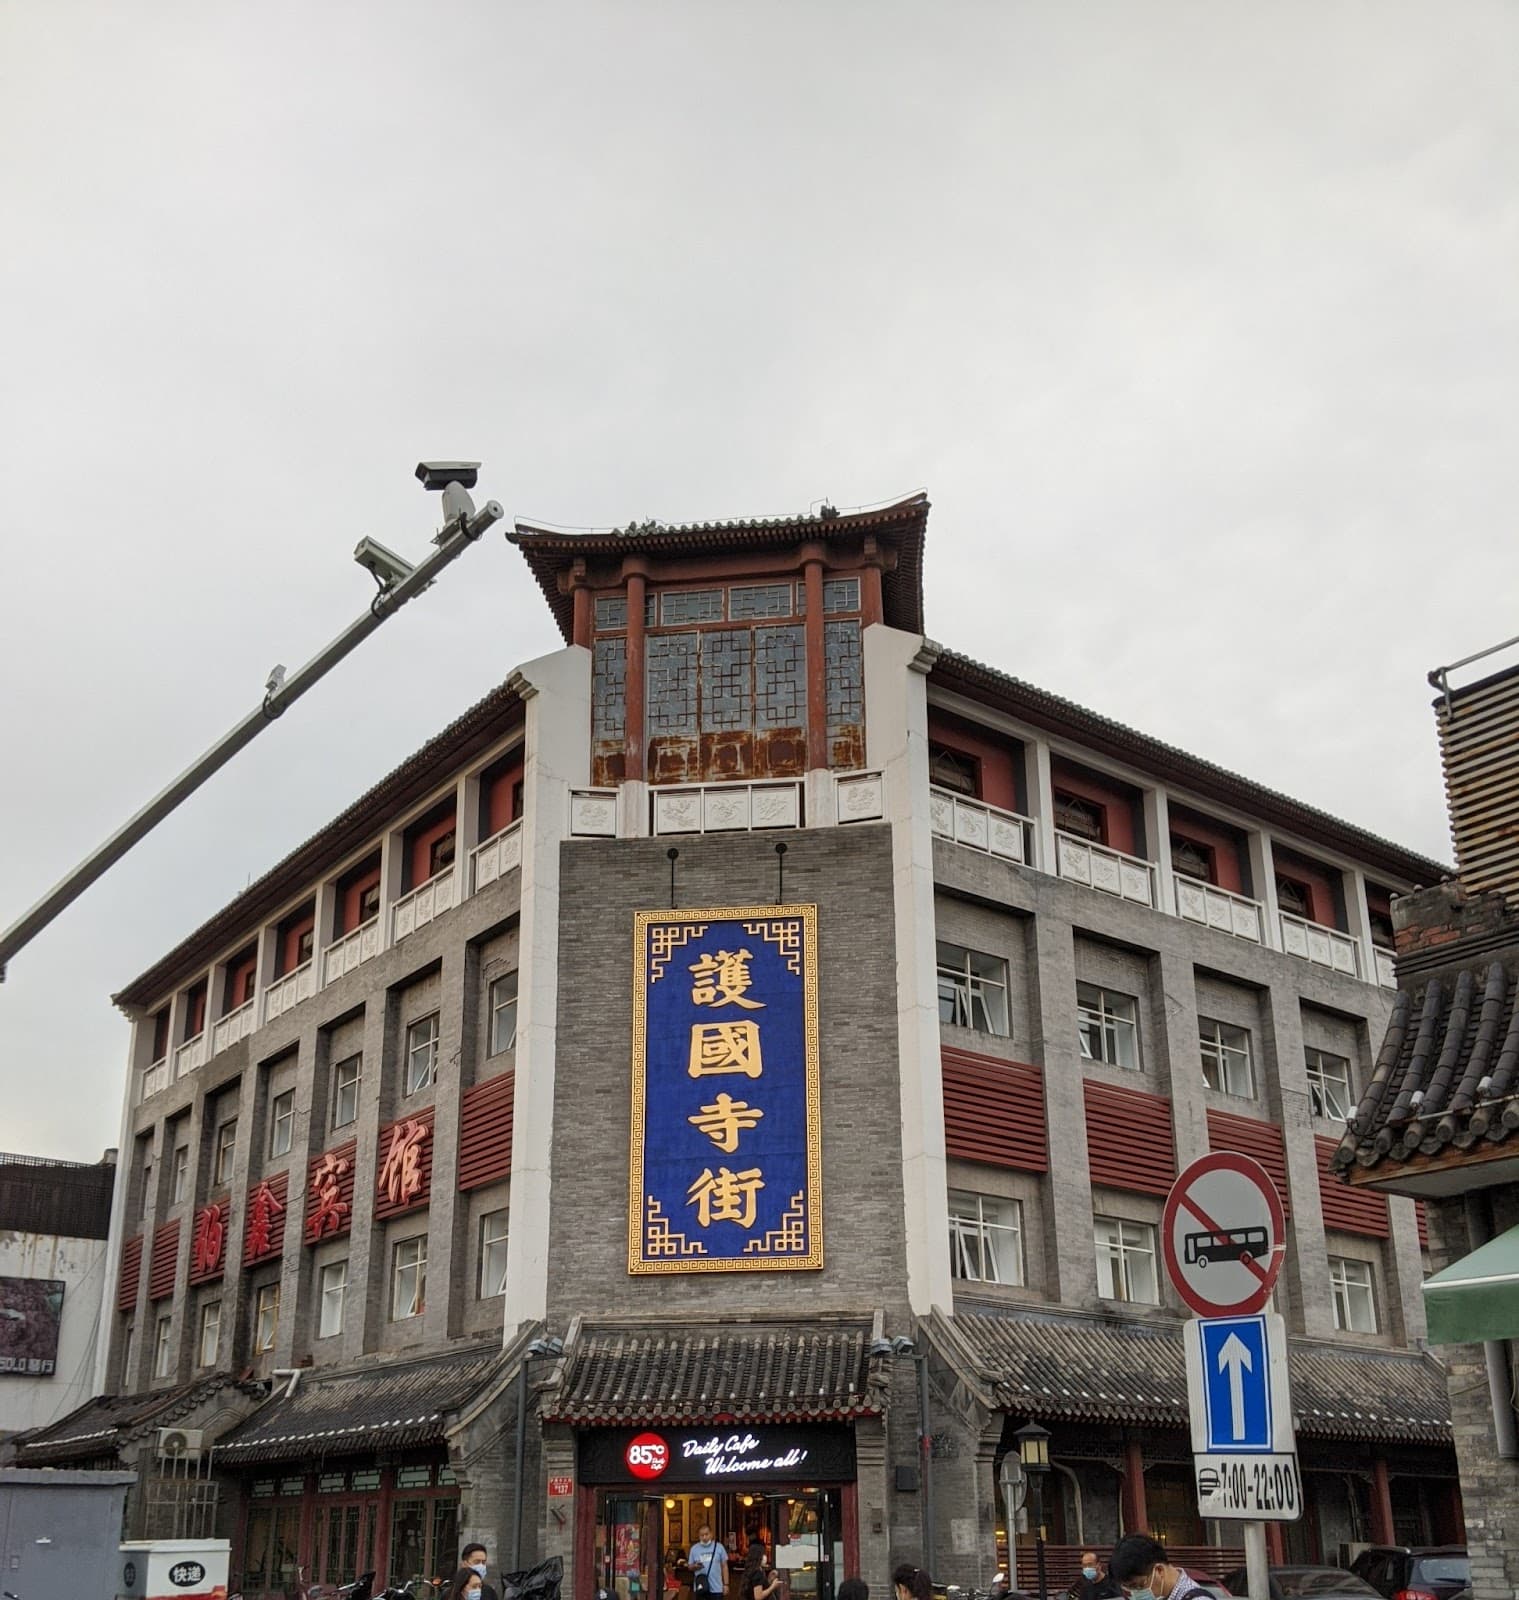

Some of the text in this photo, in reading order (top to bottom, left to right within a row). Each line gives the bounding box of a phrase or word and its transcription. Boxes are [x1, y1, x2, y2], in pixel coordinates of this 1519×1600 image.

[686, 948, 767, 1229] 護國寺街
[682, 1434, 760, 1458] Daily Cafe
[705, 1455, 774, 1476] Welcome
[1221, 1462, 1294, 1511] 7:00-22:00
[173, 1566, 202, 1583] 快递
